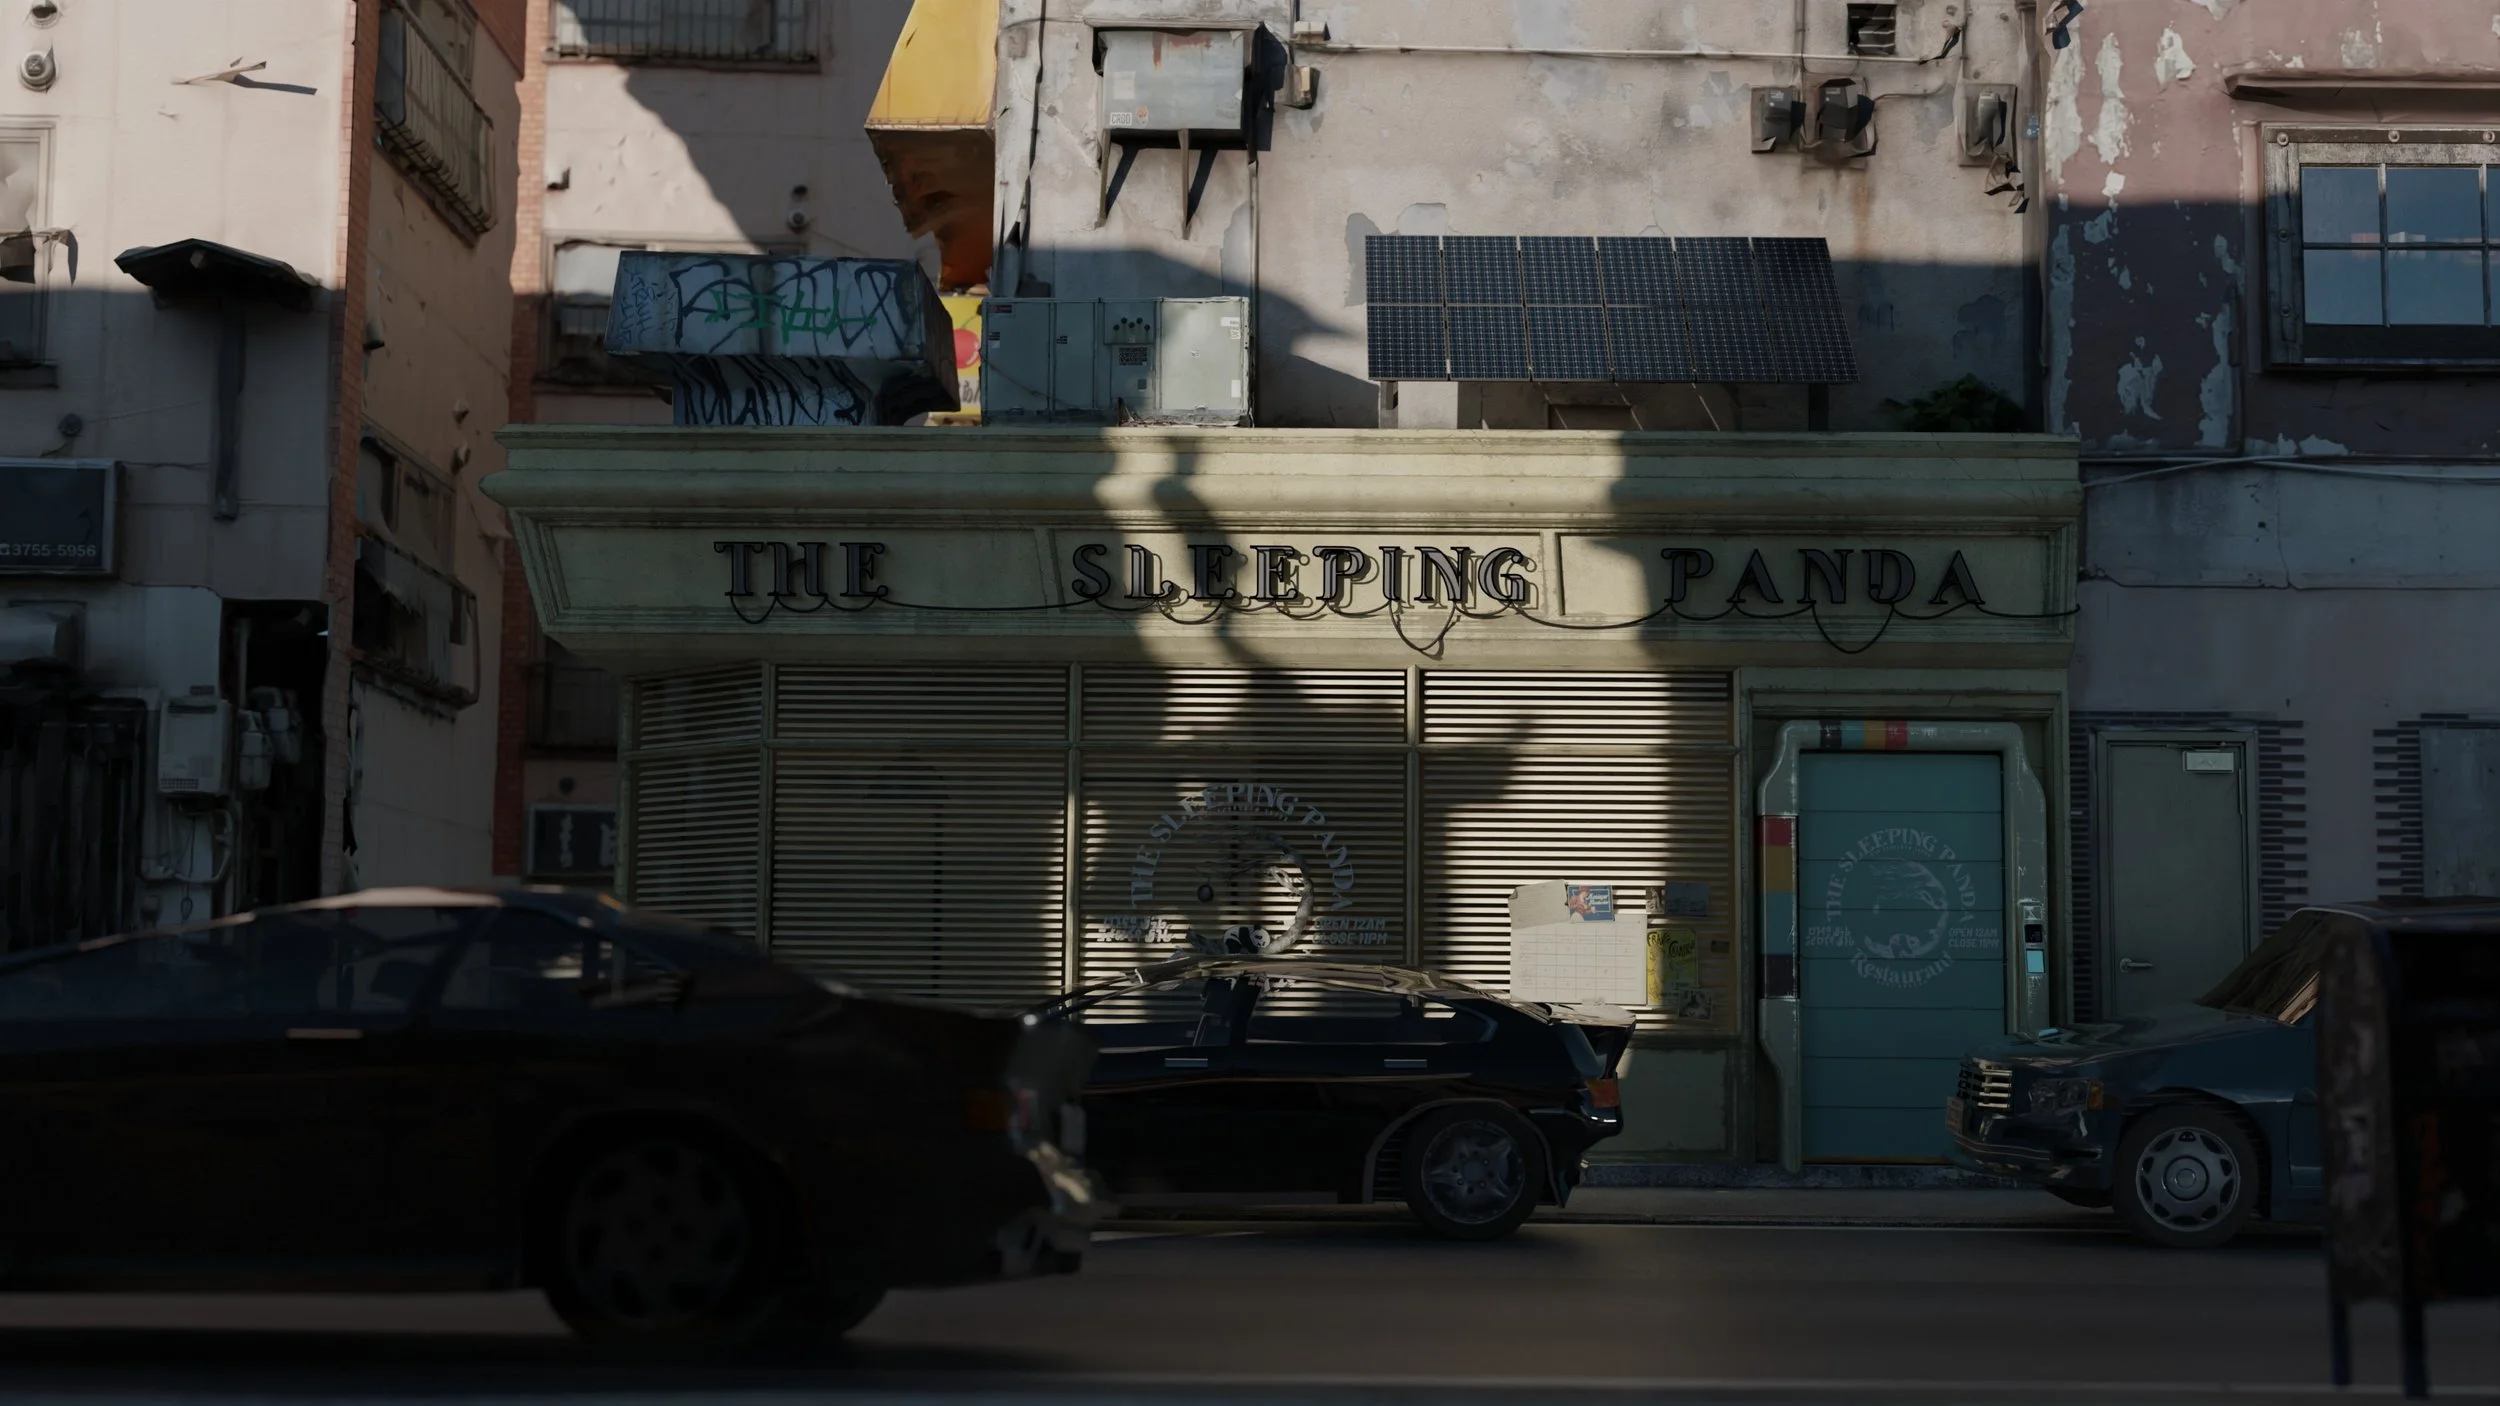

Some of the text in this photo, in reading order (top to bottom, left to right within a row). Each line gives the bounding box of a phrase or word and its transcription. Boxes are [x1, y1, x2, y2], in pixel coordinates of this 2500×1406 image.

[12, 543, 97, 557] 3755-5956
[714, 541, 1985, 604] THE SLEEPING PANDA
[1131, 783, 1356, 911] THE SLEEPING PANDA
[1826, 828, 1976, 923] THE SLEEPING PANDA
[1314, 918, 1350, 930] OPEN
[1949, 927, 1973, 937] OPEN
[1312, 931, 1356, 944] CLOSE
[1850, 948, 1956, 985] Restaurant
